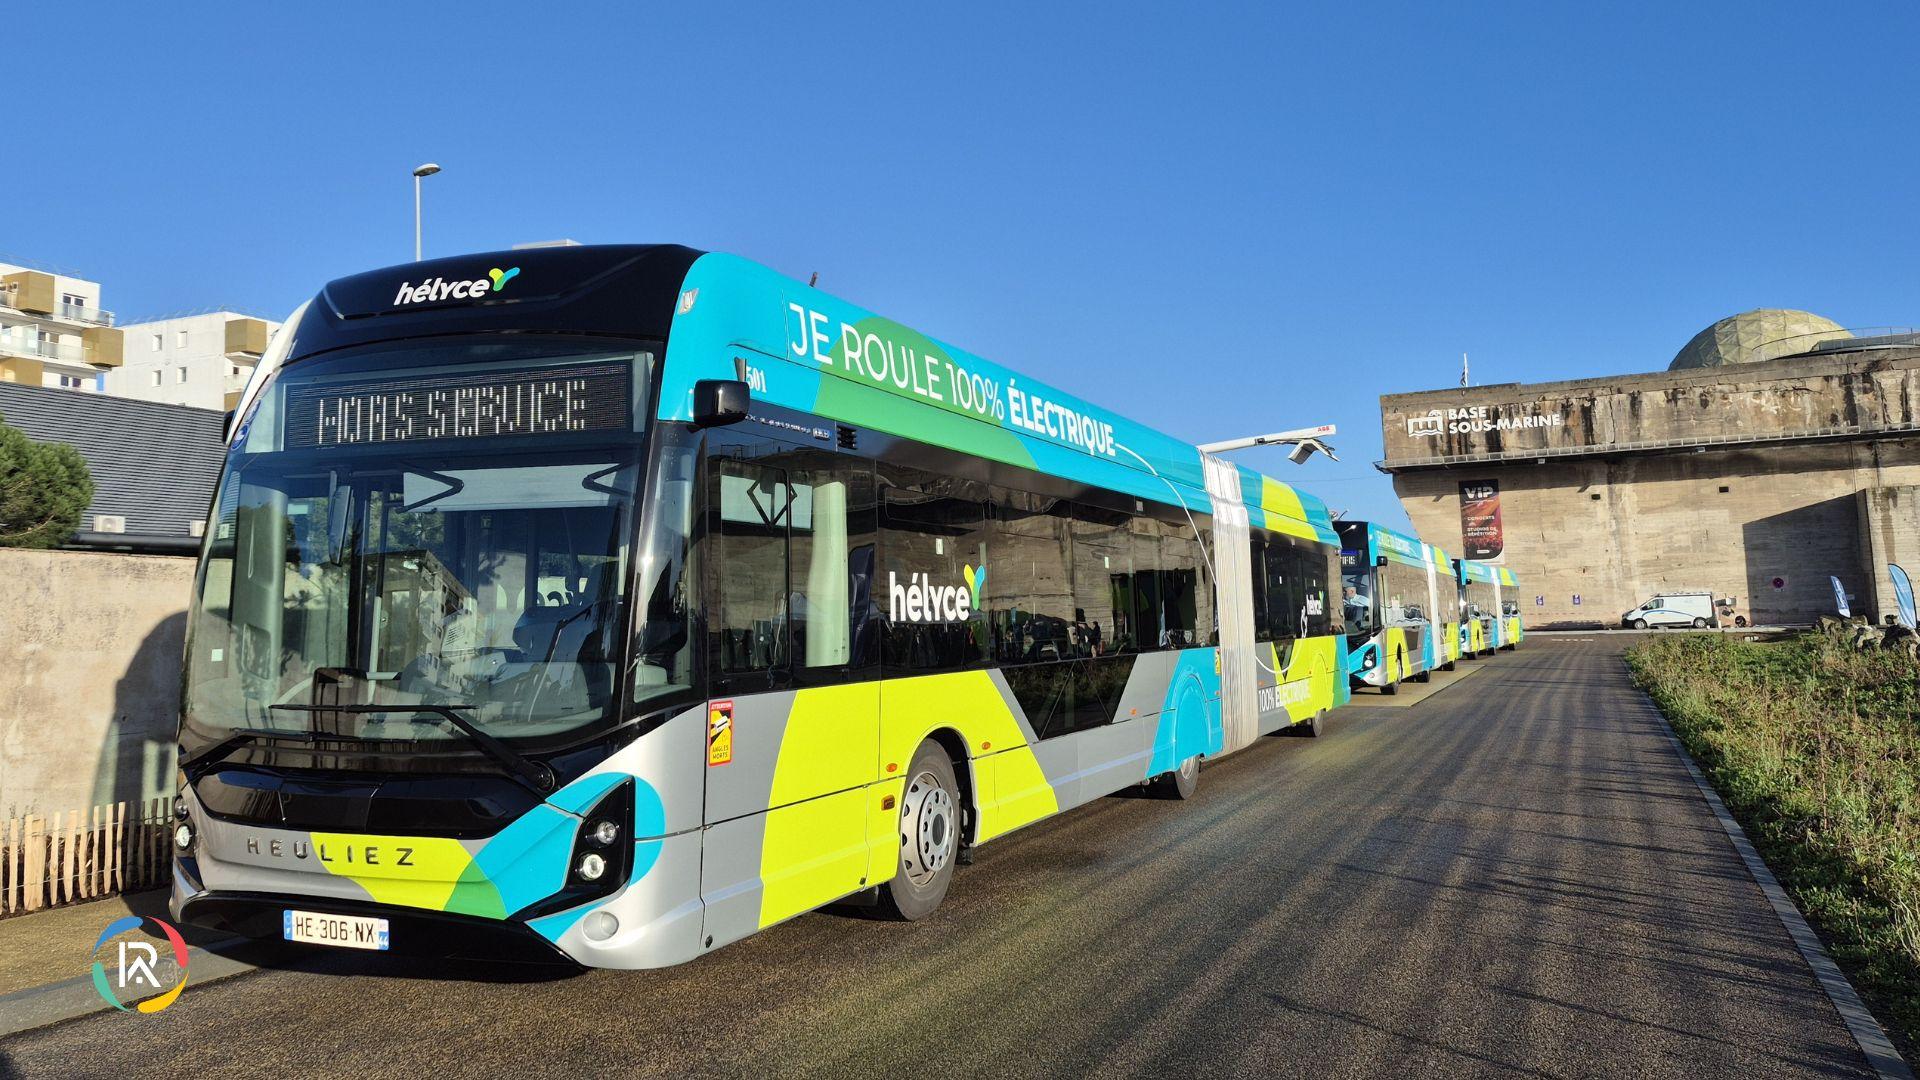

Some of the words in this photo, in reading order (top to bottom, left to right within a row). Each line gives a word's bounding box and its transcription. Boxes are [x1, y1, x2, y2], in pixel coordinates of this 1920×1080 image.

[393, 278, 490, 305] hélyce
[789, 302, 833, 365] JE
[841, 322, 943, 400] ROULE
[946, 362, 1004, 420] 100%
[1007, 378, 1116, 456] ÉLECTRIQUE
[1448, 406, 1488, 420] BASE
[1449, 414, 1561, 434] SOUS-MARINE
[889, 571, 970, 621] hélyce
[712, 752, 728, 760] MORTS
[247, 836, 414, 866] HEULIEZ
